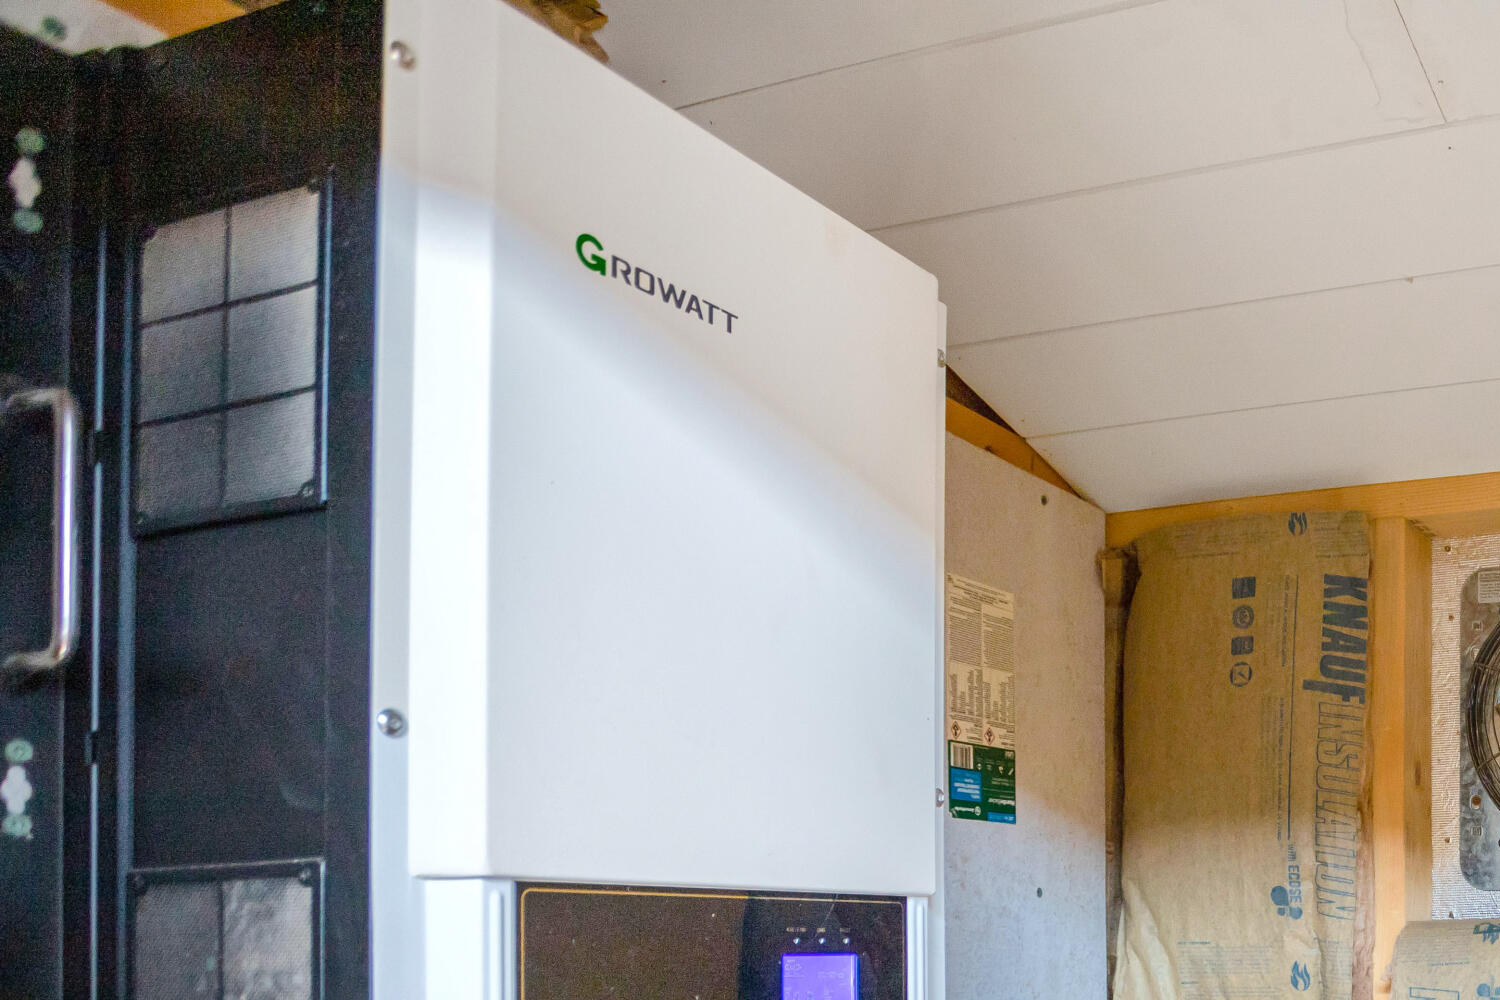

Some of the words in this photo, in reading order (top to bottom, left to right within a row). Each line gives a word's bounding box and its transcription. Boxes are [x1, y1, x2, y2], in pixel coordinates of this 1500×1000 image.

[575, 233, 739, 334] GROWATT
[1302, 573, 1369, 704] KNAUF
[1313, 702, 1367, 921] INSULATION
[1288, 864, 1303, 908] ECOSE
